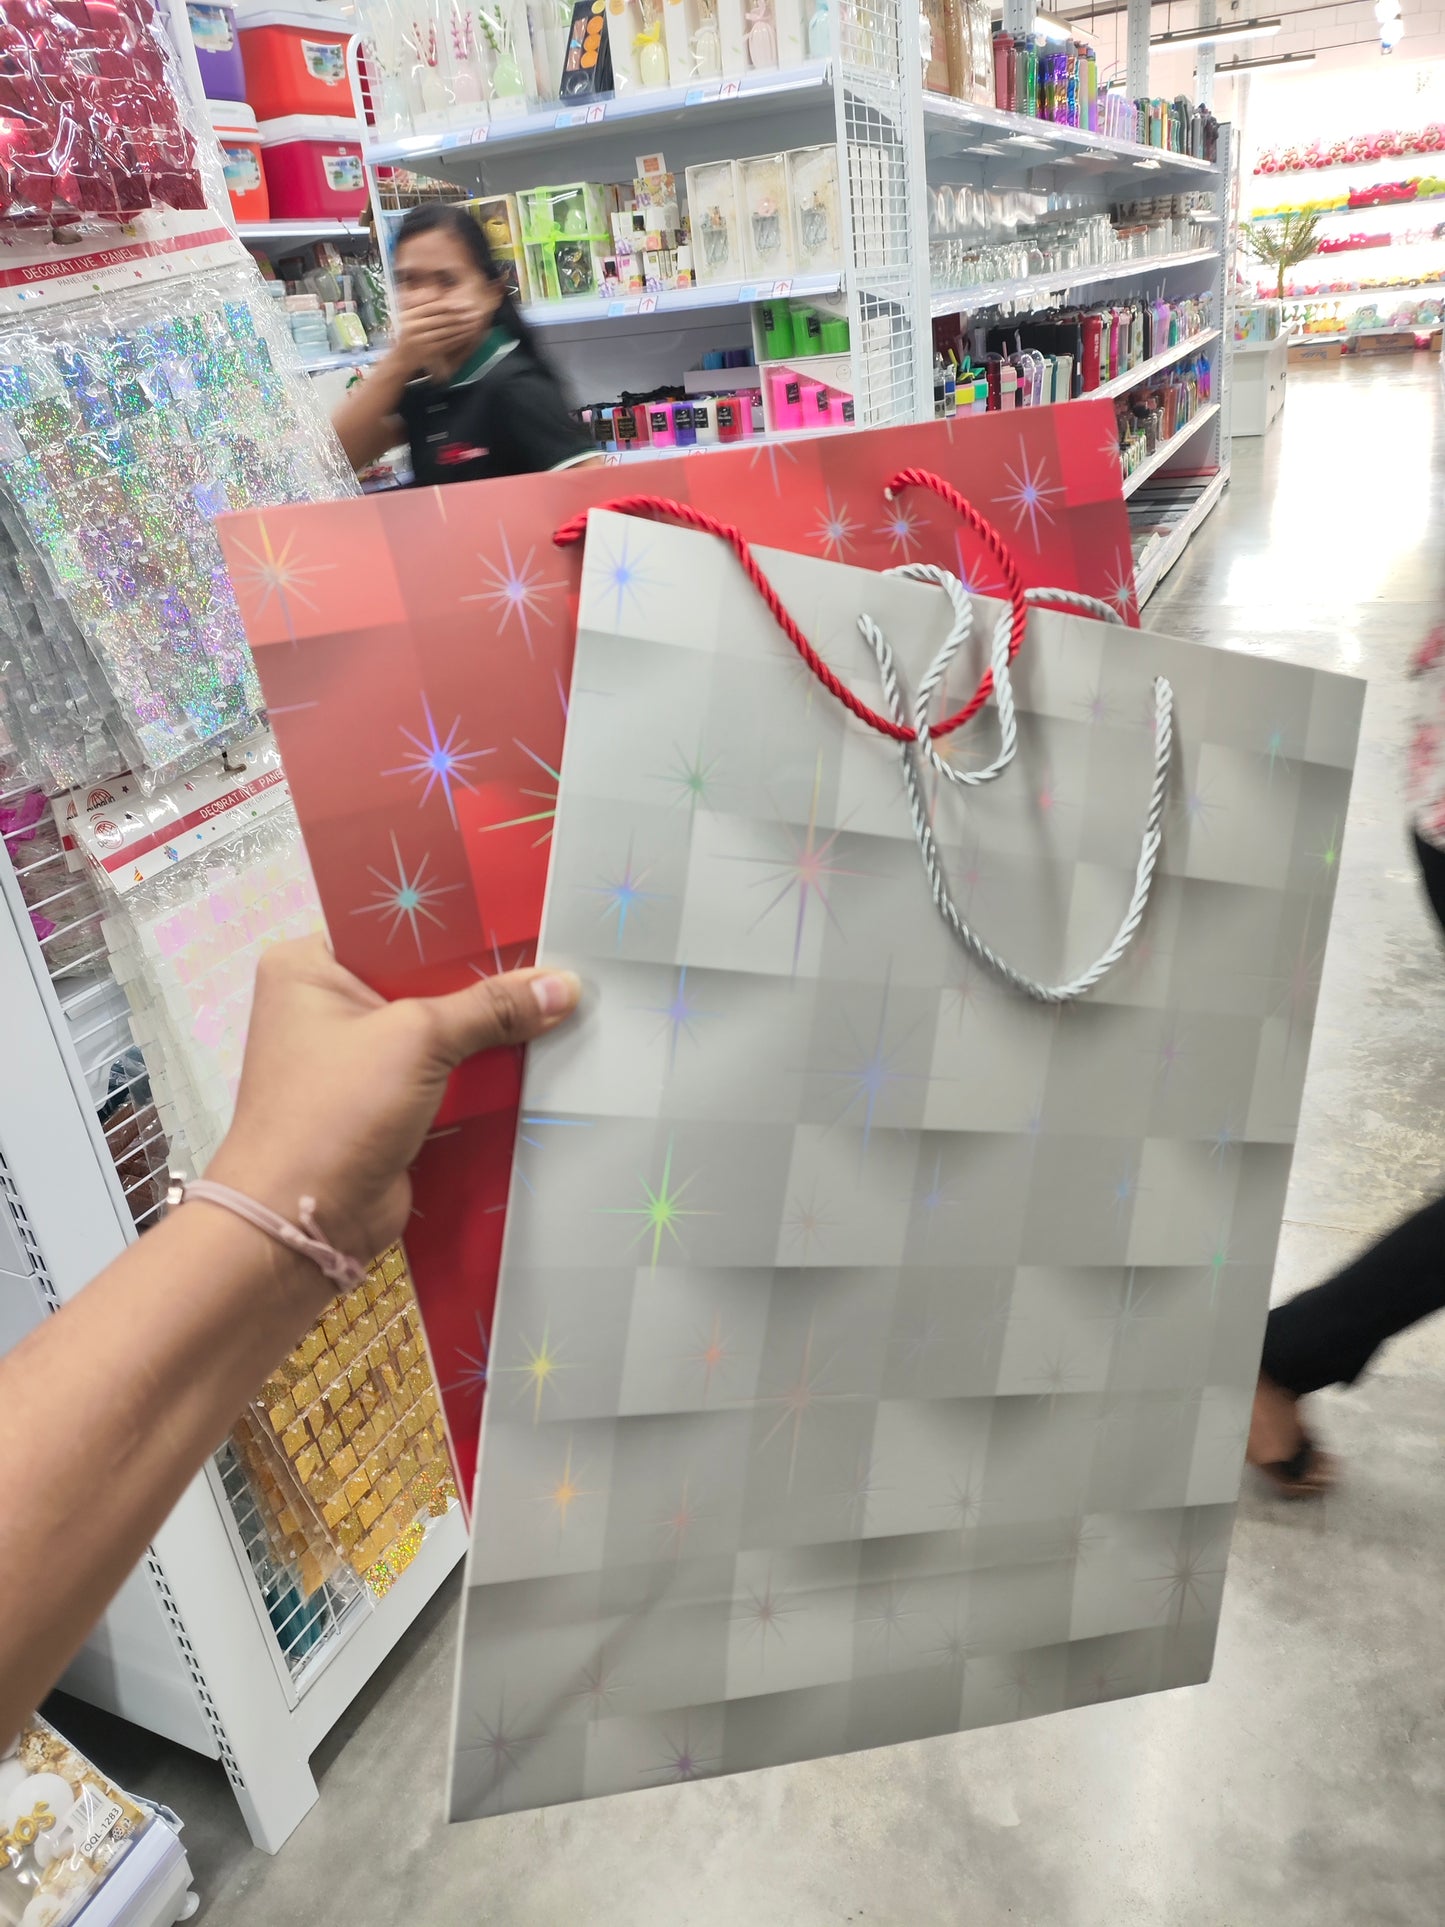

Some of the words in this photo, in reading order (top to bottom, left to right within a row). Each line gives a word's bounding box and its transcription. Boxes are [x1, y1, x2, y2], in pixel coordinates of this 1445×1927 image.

[22, 256, 98, 280] DECORATIVE
[101, 248, 137, 265] PANEL
[57, 276, 81, 287] PANEL
[82, 266, 127, 281] DECORATIVO
[199, 783, 257, 819] DECORATIVE
[84, 1807, 119, 1852] QQL-1283
